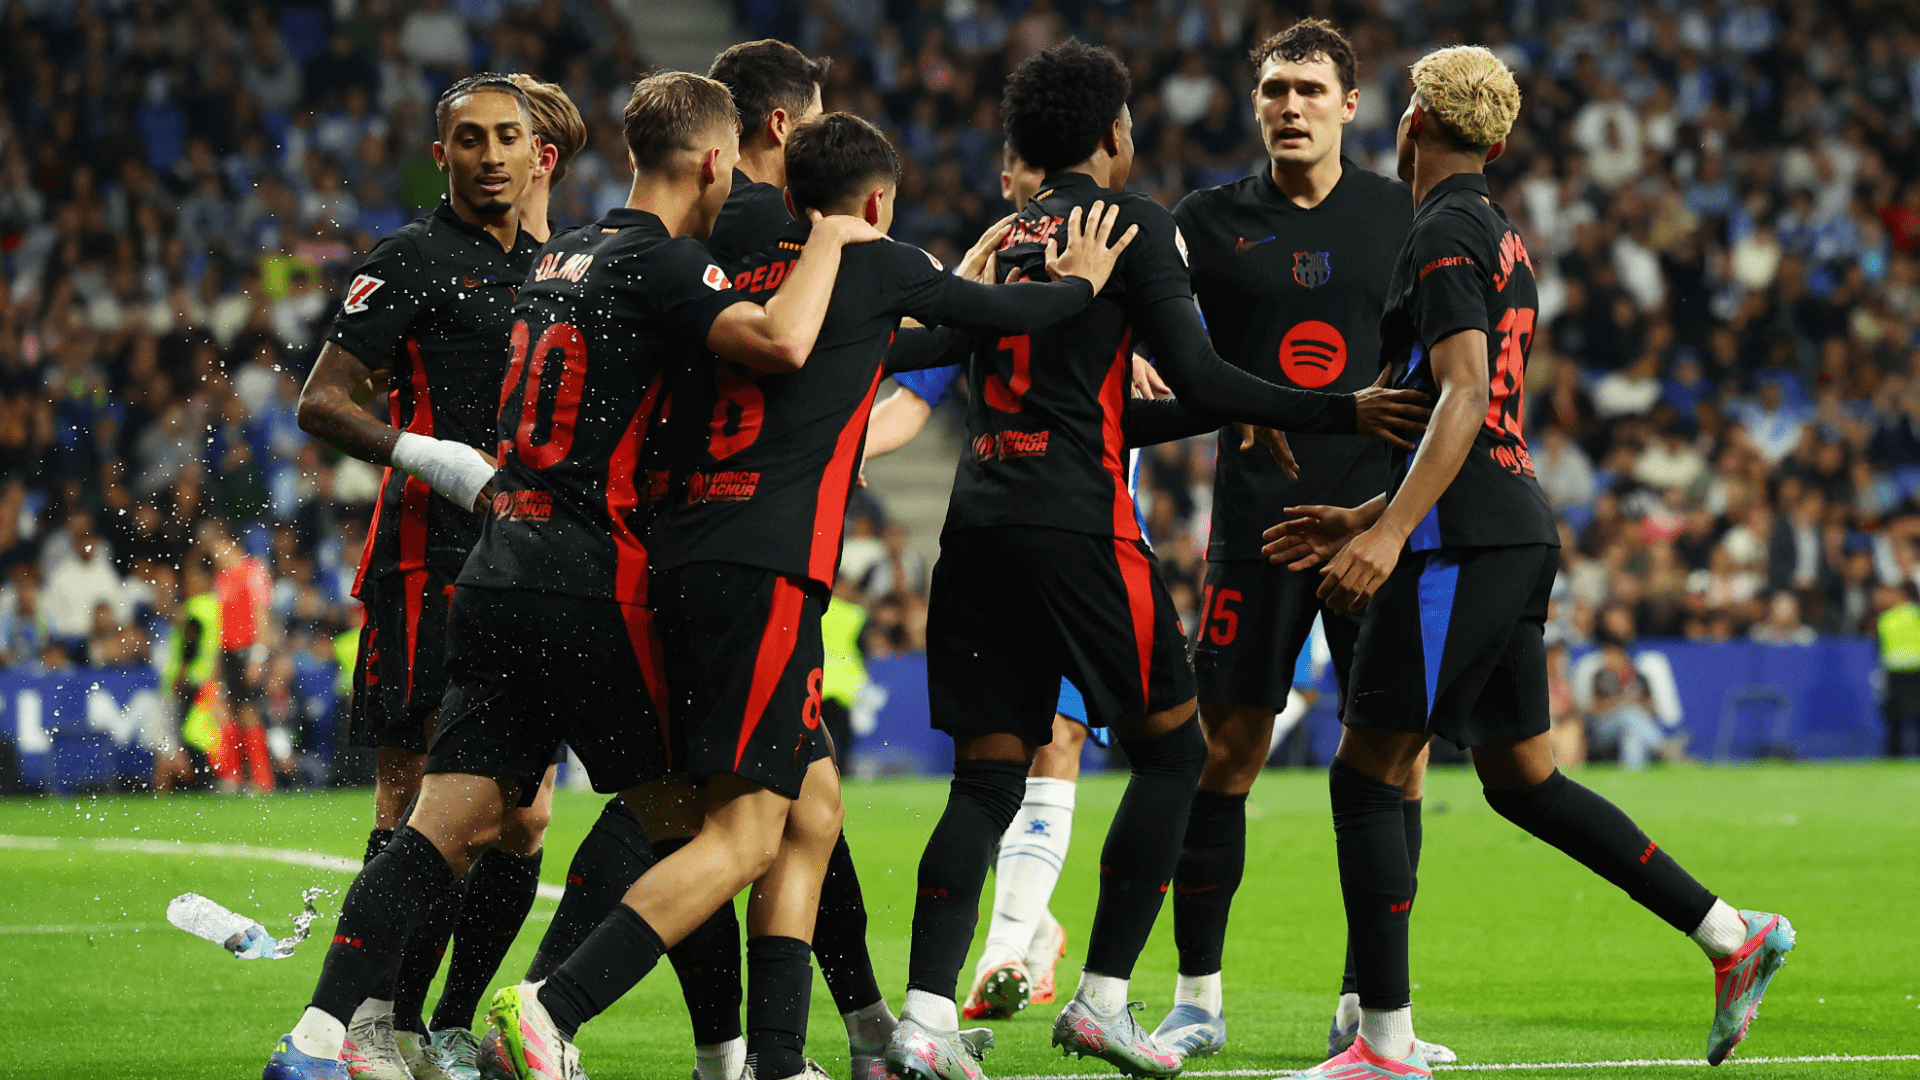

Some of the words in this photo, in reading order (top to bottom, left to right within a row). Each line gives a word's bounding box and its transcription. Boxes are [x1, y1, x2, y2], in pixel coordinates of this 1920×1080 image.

[535, 251, 594, 282] OLMO
[734, 259, 799, 293] PED
[497, 319, 588, 471] 20
[706, 483, 757, 496] ACNUR
[712, 471, 761, 485] UNHCR
[1197, 584, 1243, 646] 15
[801, 667, 824, 730] 8
